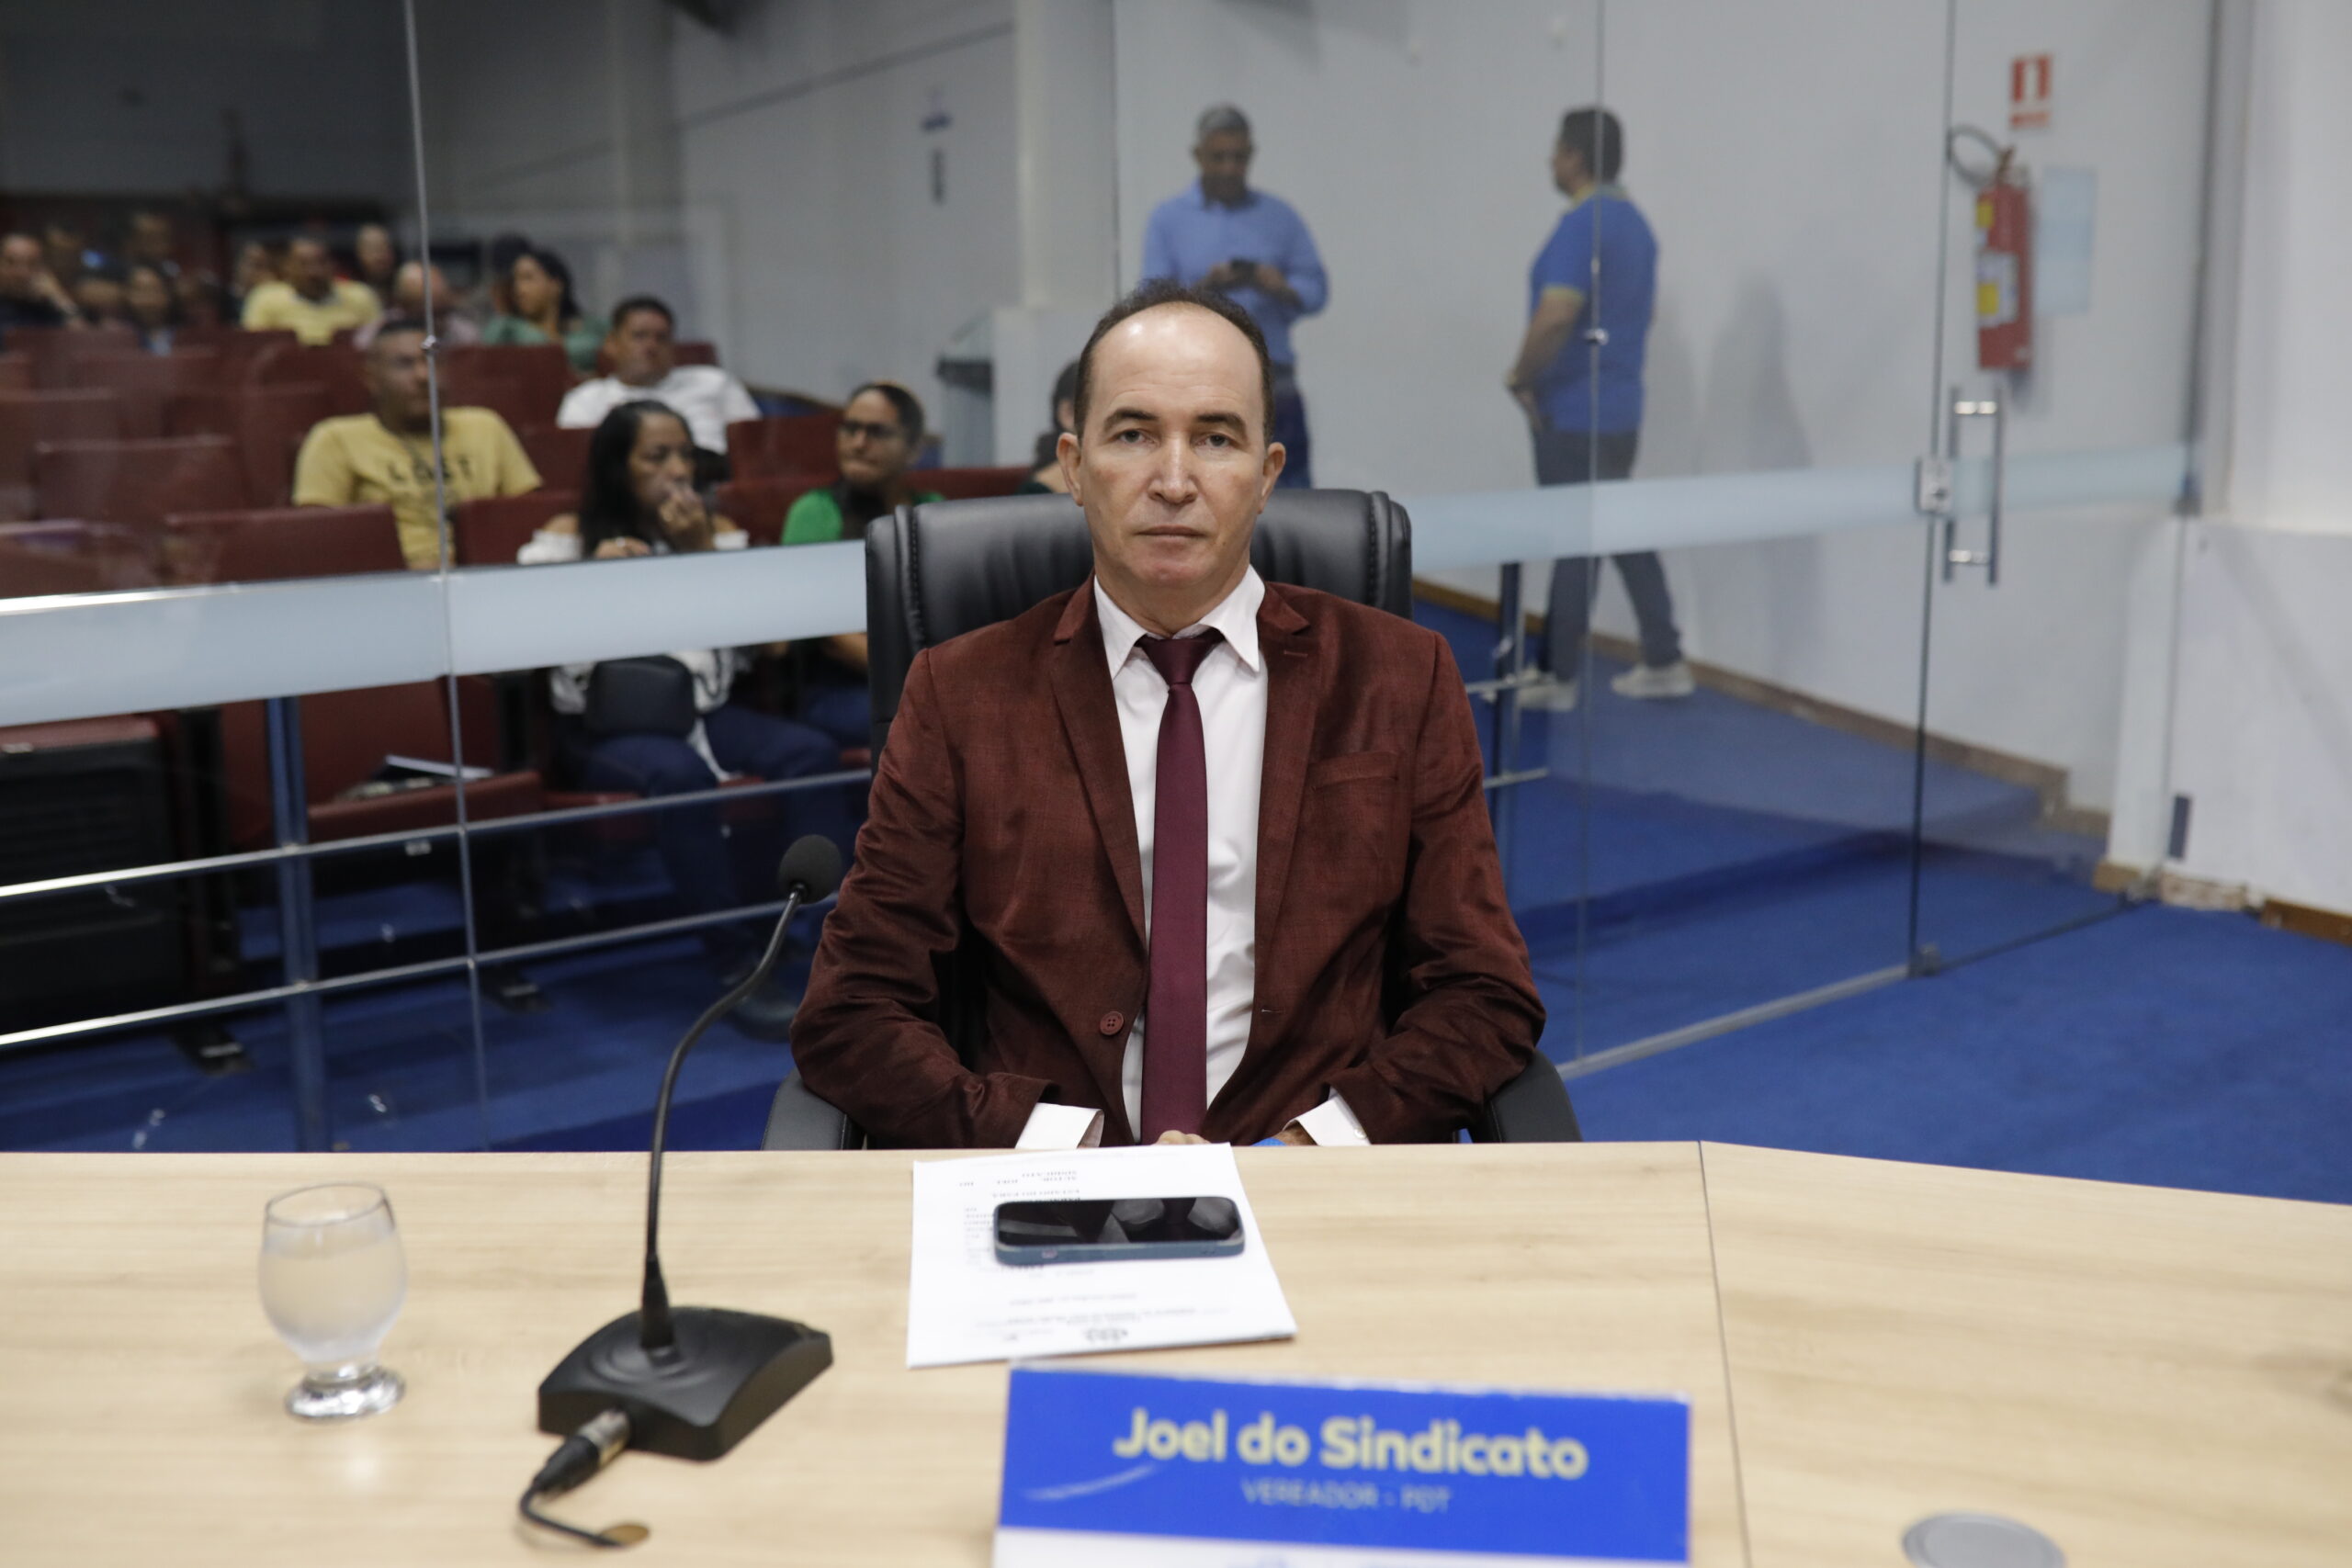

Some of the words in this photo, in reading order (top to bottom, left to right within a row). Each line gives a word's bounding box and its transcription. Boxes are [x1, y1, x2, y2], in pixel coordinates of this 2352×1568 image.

[1113, 1406, 1227, 1461] Joel
[1237, 1411, 1311, 1467] do
[1320, 1415, 1589, 1480] Sindicato
[1241, 1476, 1378, 1509] VEREADOR
[1400, 1483, 1452, 1513] PDT
